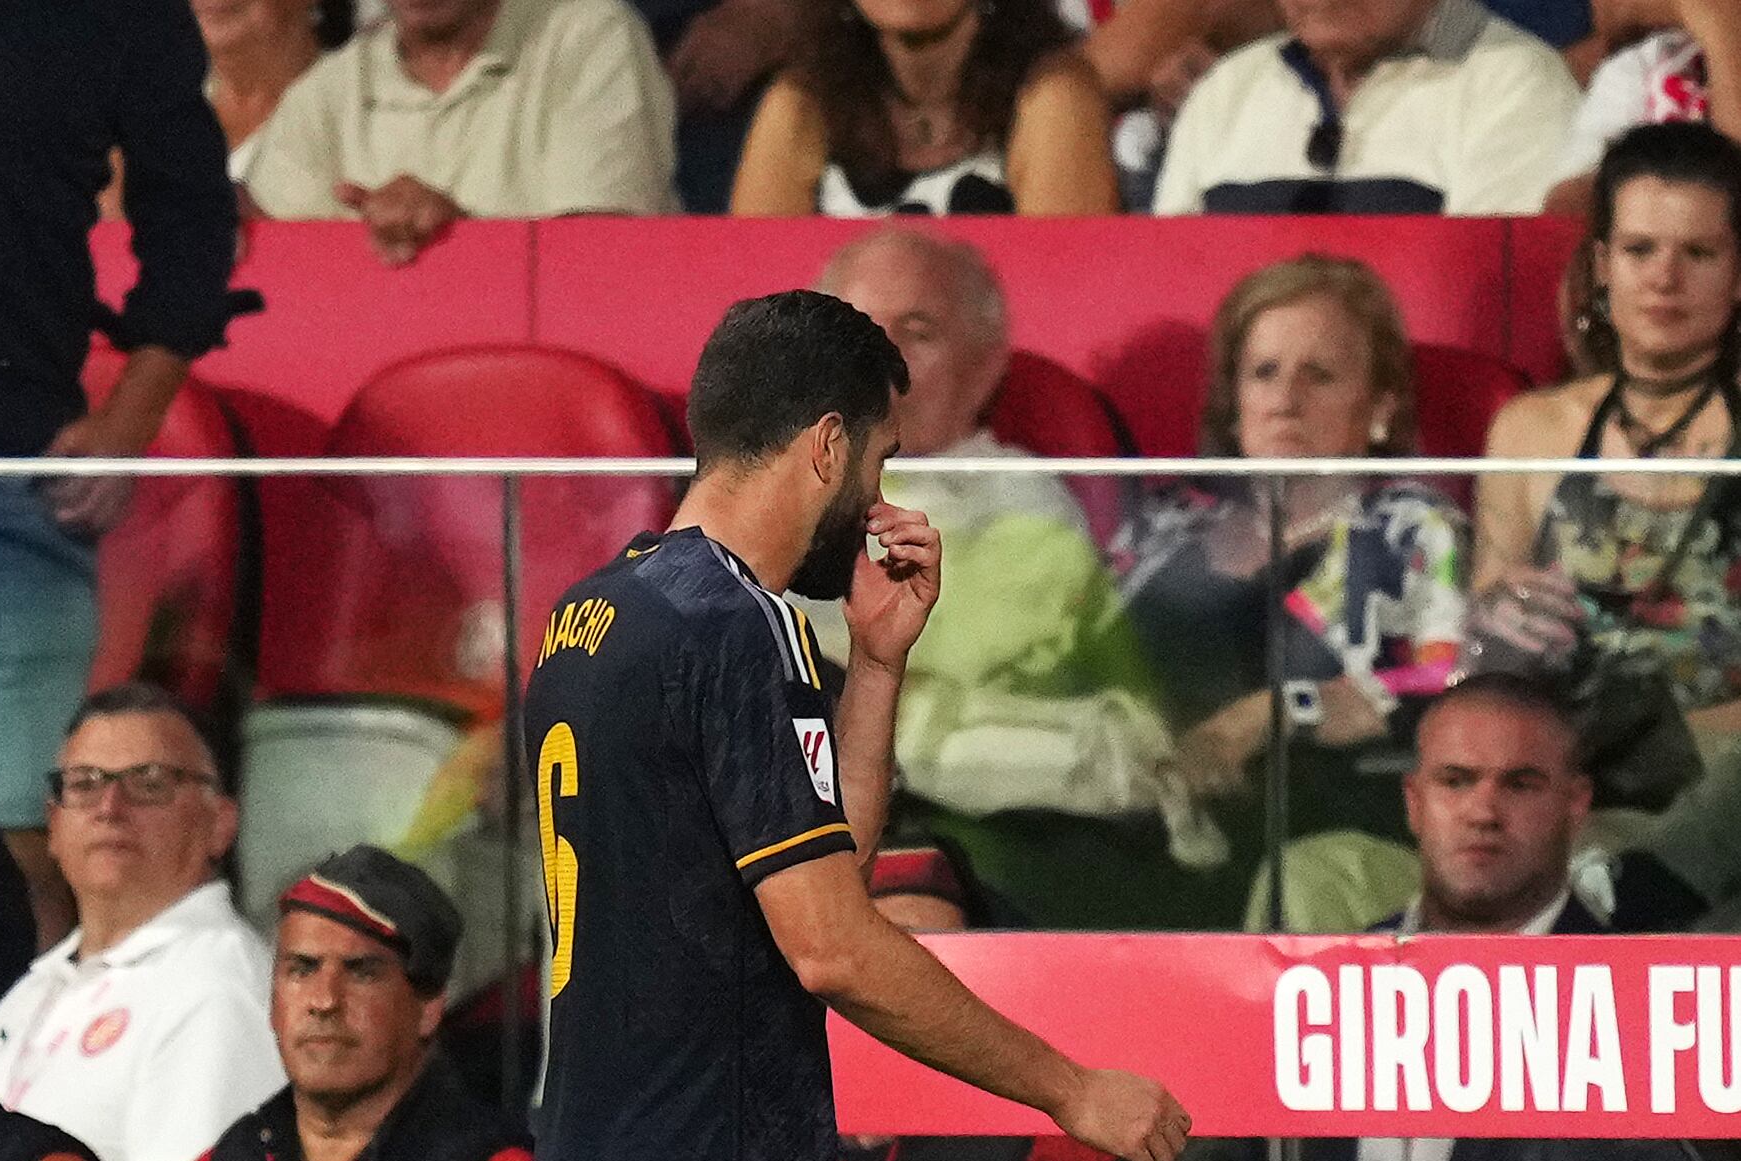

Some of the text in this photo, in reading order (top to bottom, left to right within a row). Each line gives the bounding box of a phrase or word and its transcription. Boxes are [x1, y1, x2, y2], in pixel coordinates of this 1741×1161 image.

[538, 597, 615, 668] NACHO
[537, 721, 579, 1000] 6
[1273, 964, 1629, 1112] GIRONA
